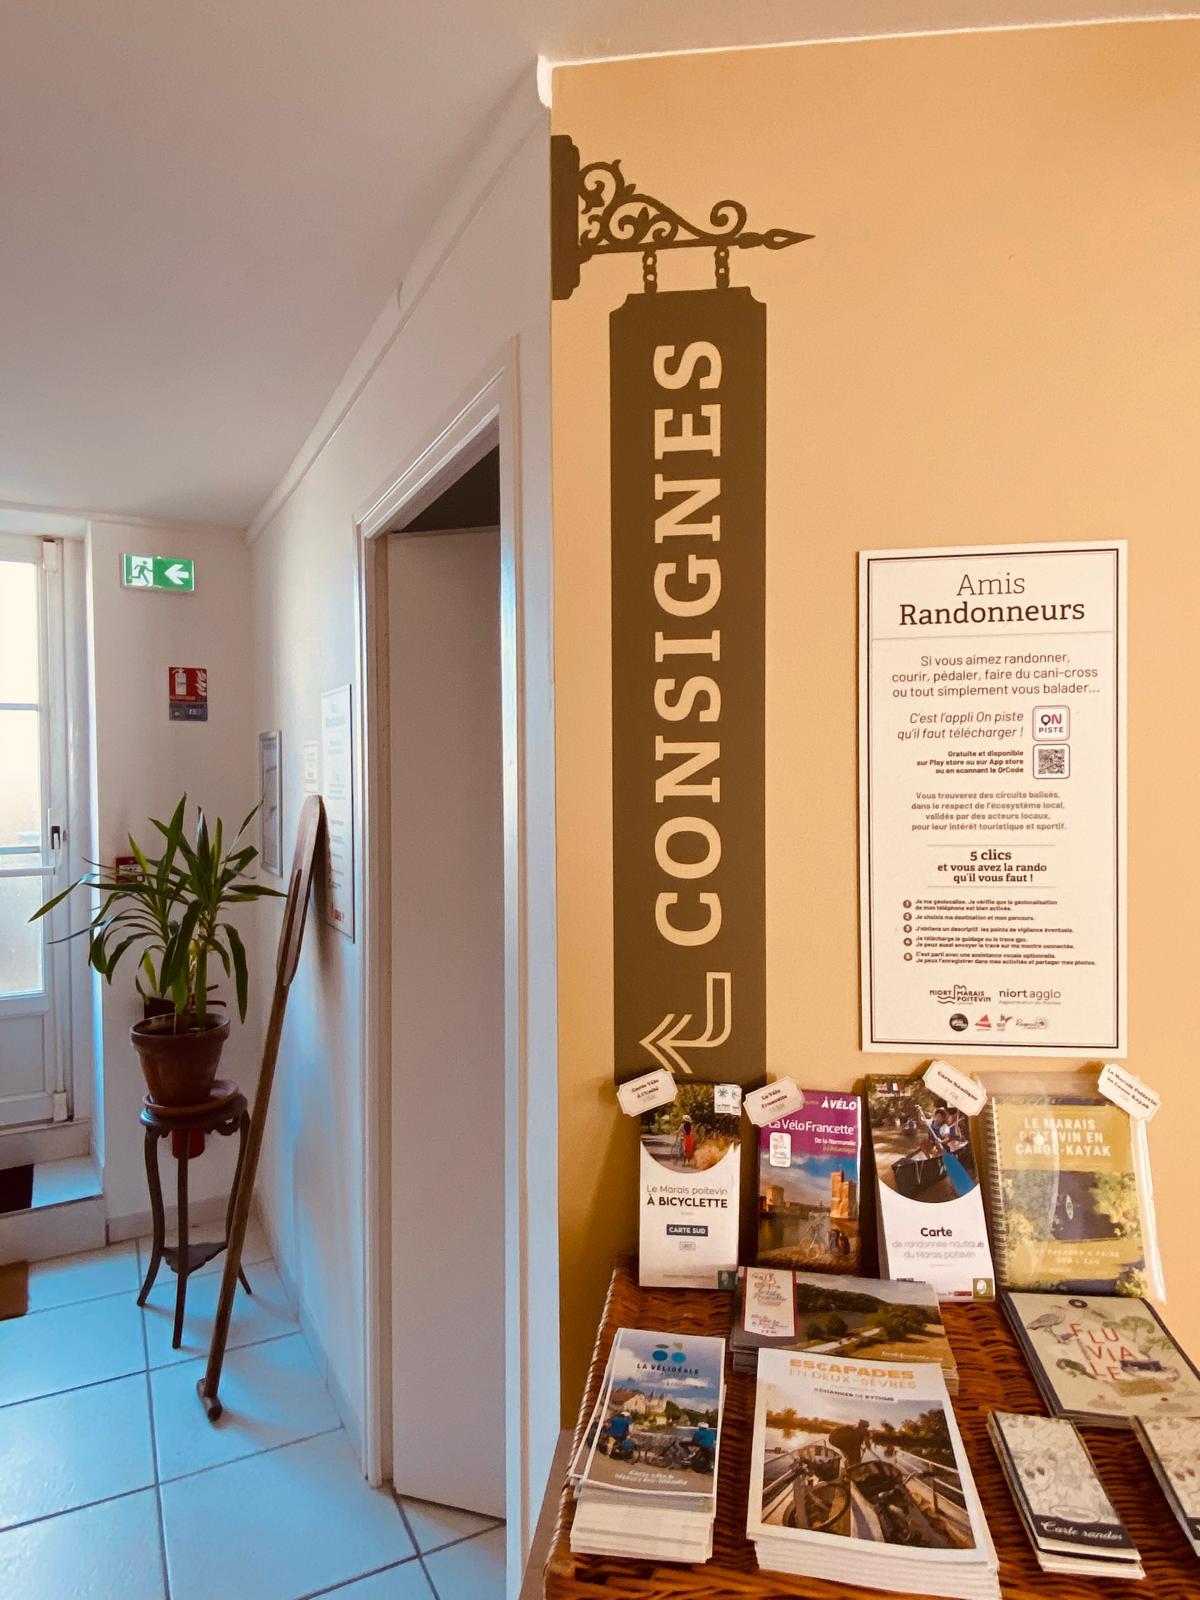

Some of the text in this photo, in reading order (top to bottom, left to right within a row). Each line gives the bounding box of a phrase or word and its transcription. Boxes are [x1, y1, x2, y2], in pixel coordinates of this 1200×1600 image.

[957, 572, 1025, 596] Amis
[899, 601, 1085, 625] Randonneurs
[653, 340, 722, 947] CONSIGNES
[921, 652, 1070, 666] Si vous aimez randonner,
[892, 668, 1098, 684] courir, pédaler, faire du cani-cross
[892, 683, 1100, 698] ou tout simplement vous balader...
[910, 711, 1024, 725] C'est l'appli On piste
[1040, 714, 1062, 725] ON
[897, 729, 920, 741] qu'il
[922, 728, 946, 739] faut
[949, 727, 1017, 740] télécharger
[995, 791, 1027, 799] circuits
[941, 803, 973, 811] respect
[925, 812, 954, 820] validés
[979, 823, 1024, 831] touristique
[970, 849, 1012, 861] 5 clics
[937, 863, 1047, 872] et vous avez la rando
[953, 873, 976, 884] qu'il
[1006, 873, 1027, 882] faut
[821, 1096, 829, 1108] À
[830, 1098, 857, 1110] VÉLO
[1024, 1118, 1096, 1130] LE MARAIS
[1086, 1132, 1104, 1143] EN
[647, 1185, 728, 1196] Le Marais poitevin
[647, 1194, 728, 1208] À BICYCLETTE
[920, 1227, 953, 1237] Carte
[789, 1359, 914, 1379] ESCAPADES
[1041, 1521, 1123, 1540] Carte randos
